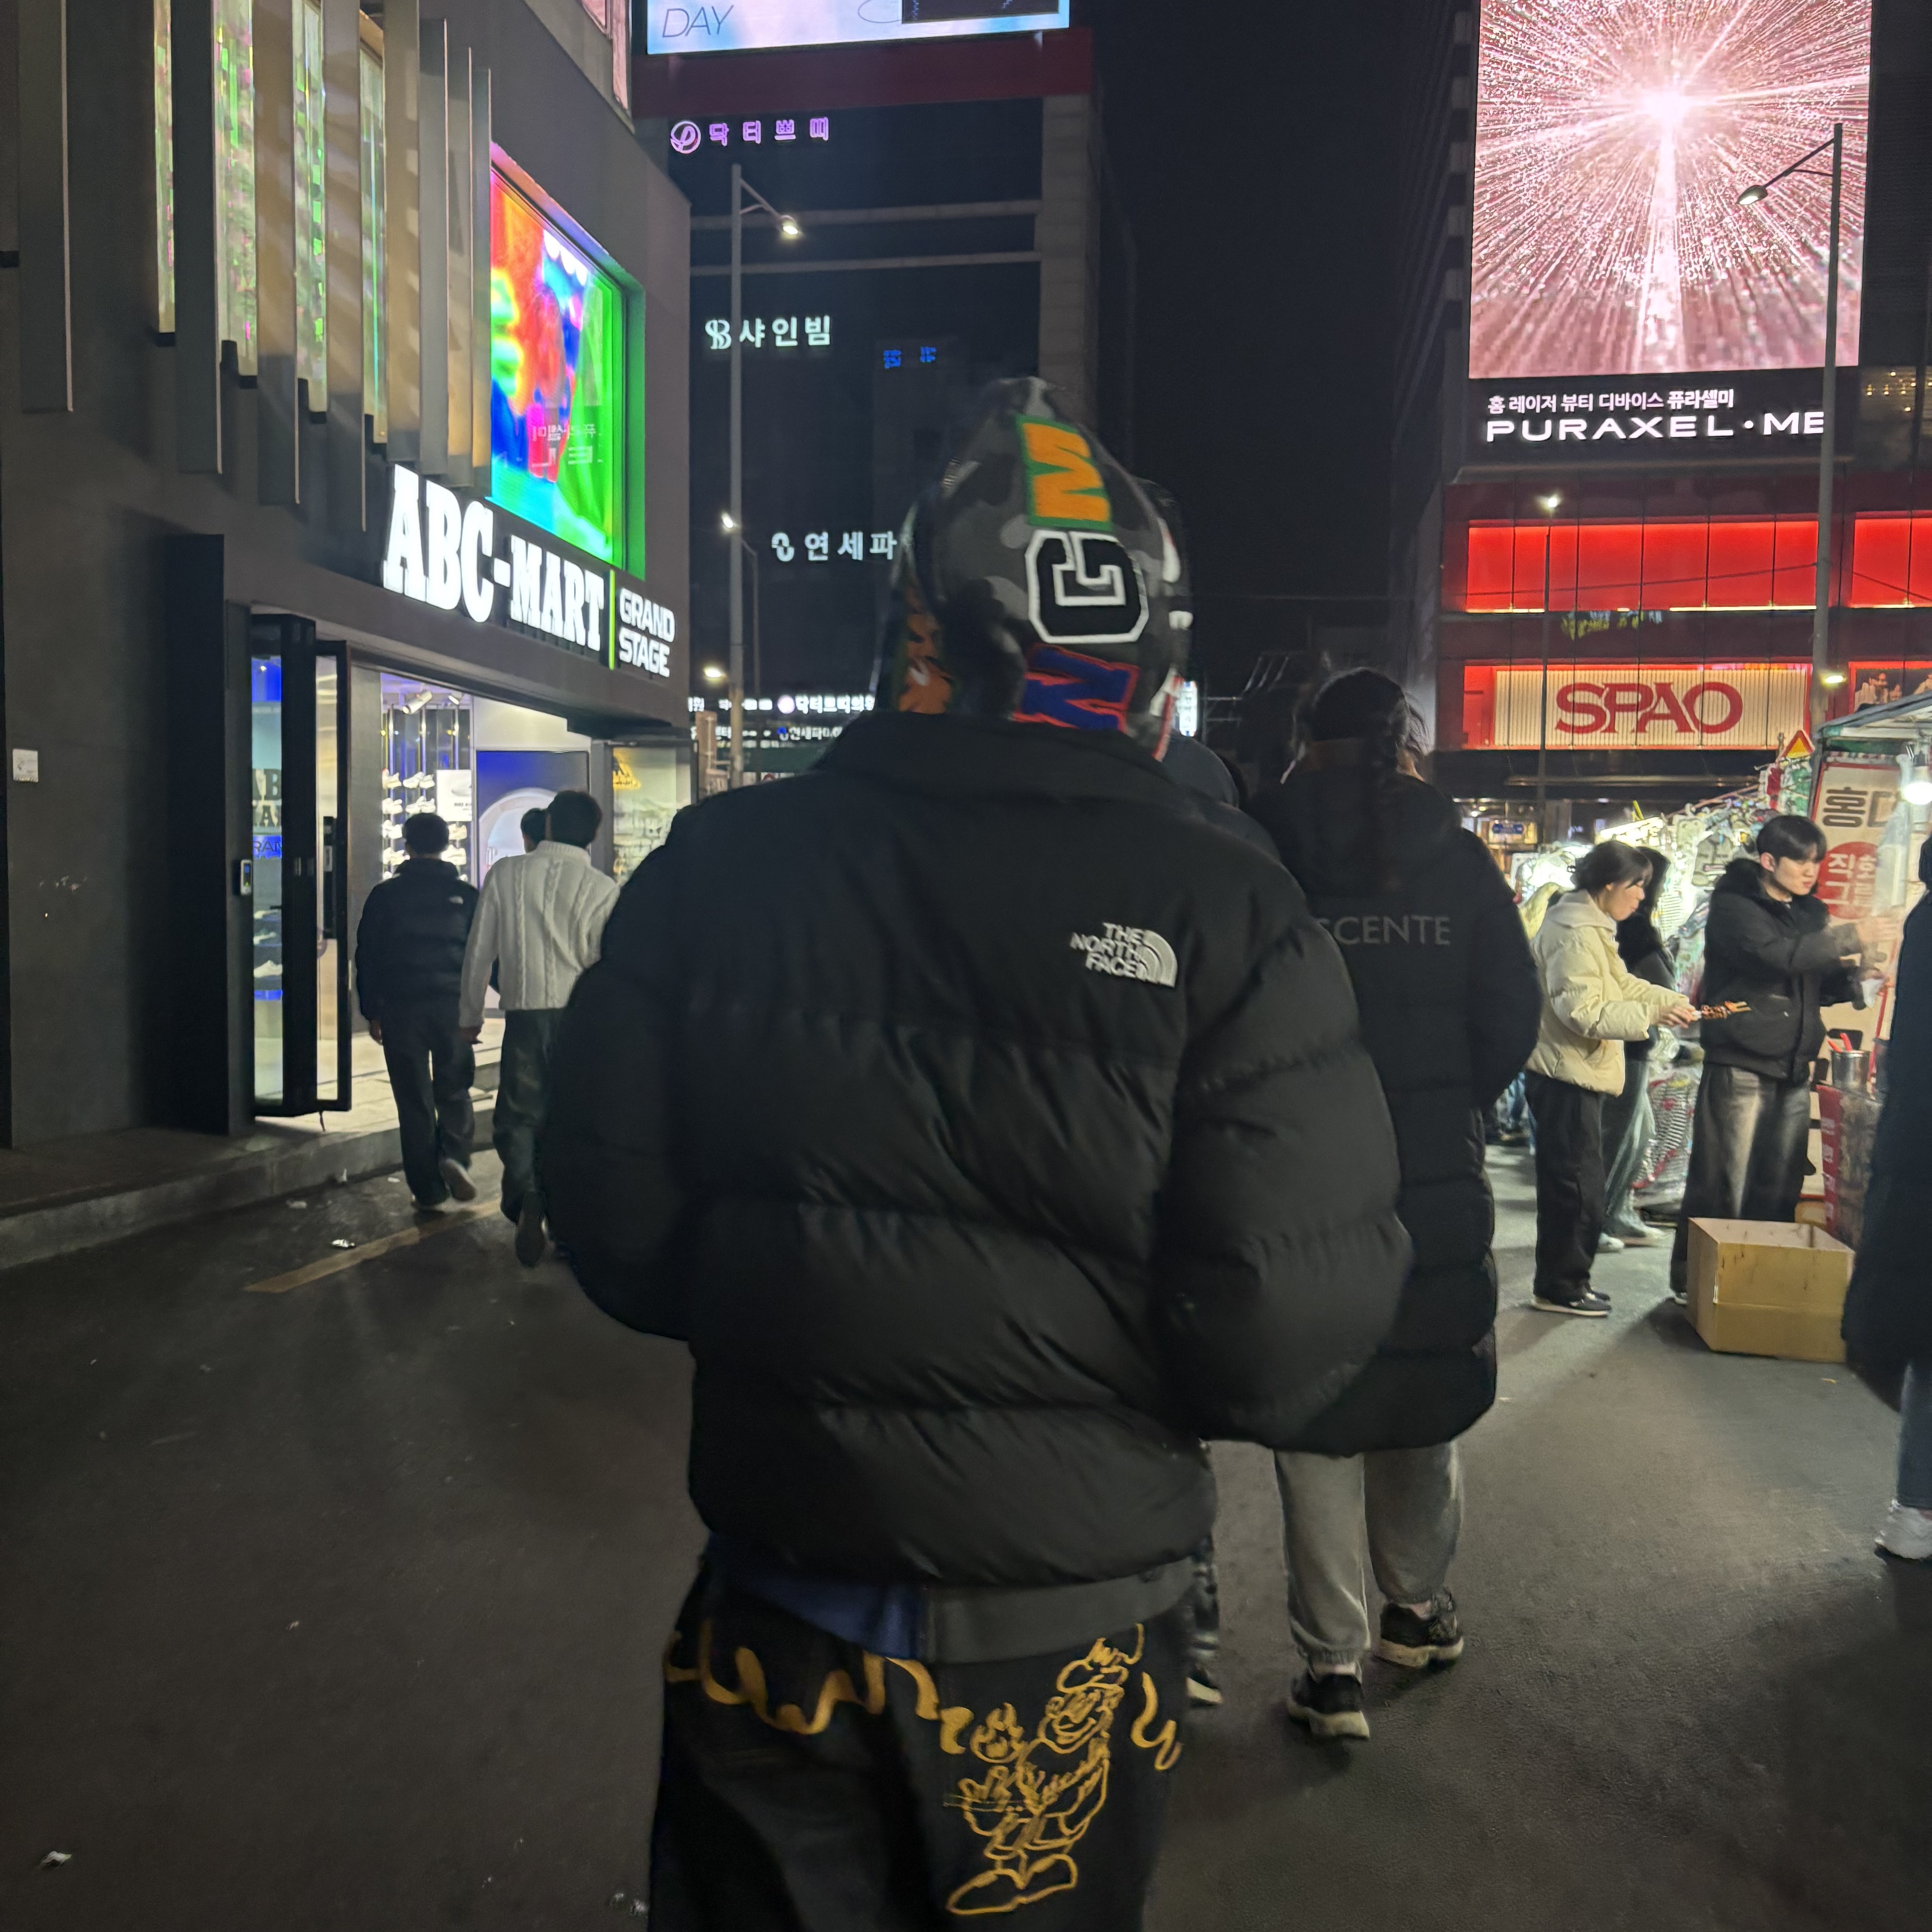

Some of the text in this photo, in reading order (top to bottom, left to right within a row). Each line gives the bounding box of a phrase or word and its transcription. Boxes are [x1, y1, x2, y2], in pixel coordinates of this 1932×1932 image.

[662, 5, 734, 38] DAY
[739, 315, 831, 348] 샤인빔
[1487, 389, 1734, 414] 홈 레이저 뷰티 디바이스 퓨라셀미
[383, 463, 604, 651] ABC-MART
[619, 587, 675, 643] GRAND
[619, 627, 670, 677] STAGE
[1555, 681, 1743, 736] SPAO
[1069, 932, 1140, 961] NORTH
[1102, 922, 1145, 946] THE
[1315, 914, 1451, 946] CENTE
[1085, 951, 1137, 978] FACE
